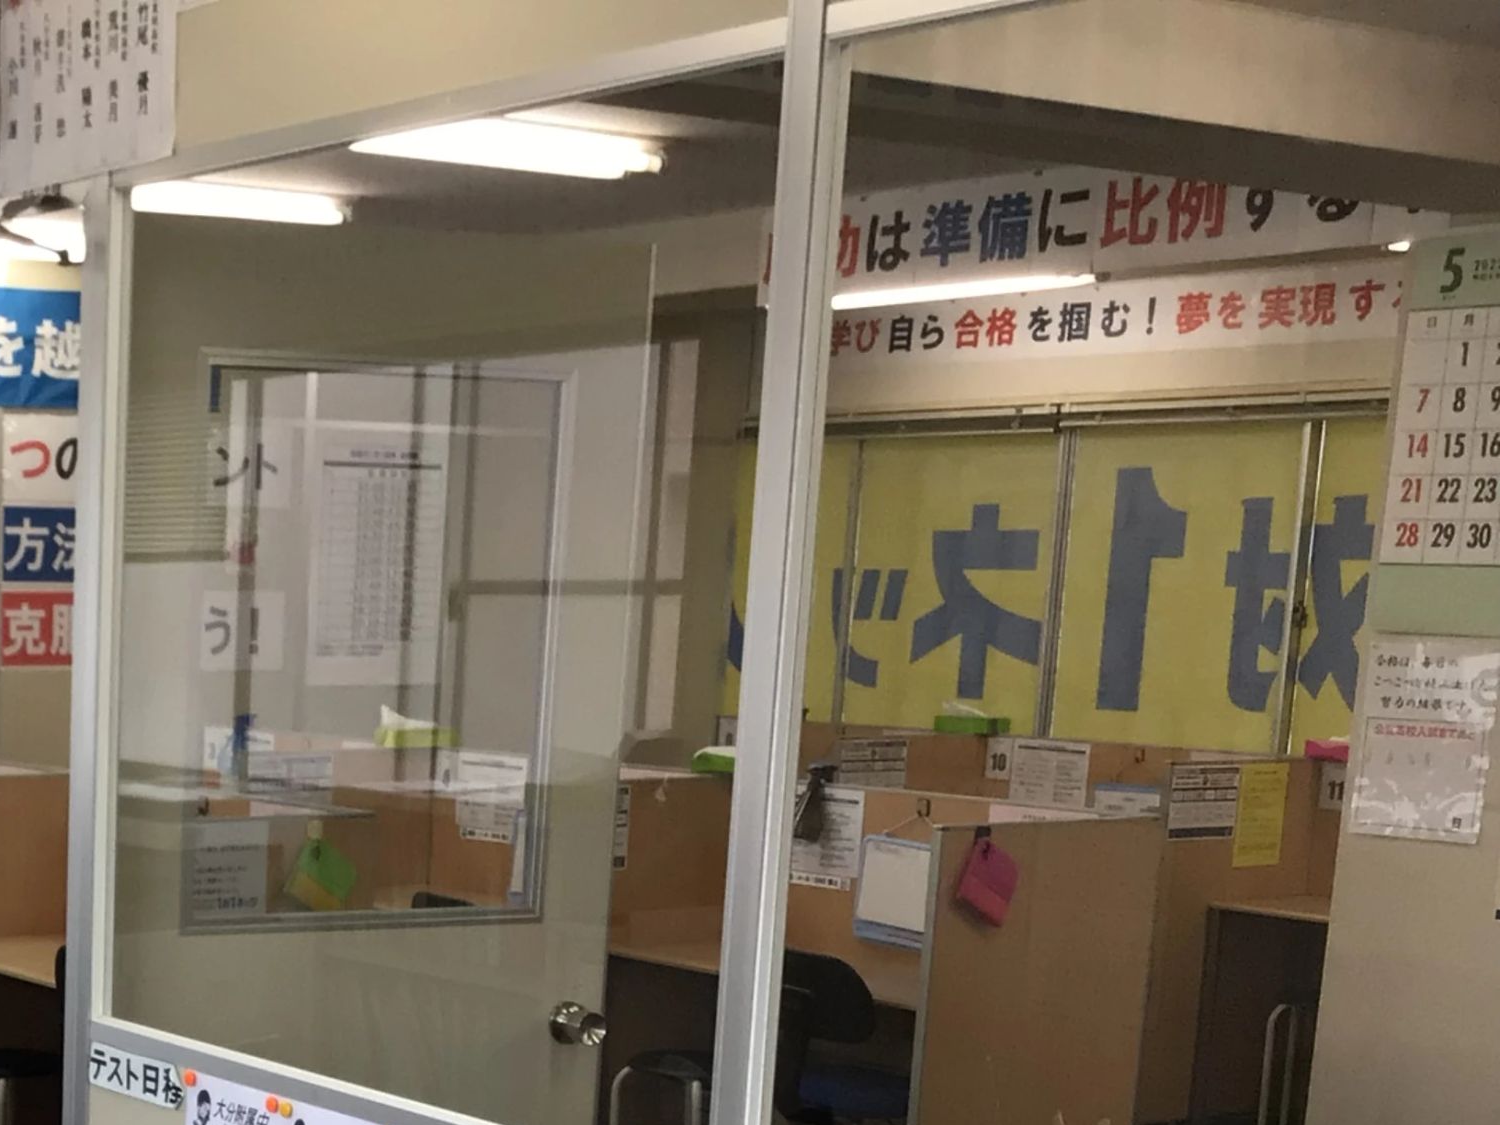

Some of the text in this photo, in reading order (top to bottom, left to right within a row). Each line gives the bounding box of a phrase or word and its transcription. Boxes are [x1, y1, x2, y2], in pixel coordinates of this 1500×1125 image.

[1440, 247, 1466, 294] 5
[1461, 341, 1470, 367] 1
[1417, 388, 1431, 413] 7
[1452, 387, 1467, 412] 8
[1407, 433, 1429, 458] 14
[1444, 433, 1467, 458] 15
[1400, 477, 1498, 503] 21 22 23
[1394, 522, 1493, 549] 28 29 30
[990, 752, 1008, 773] 10
